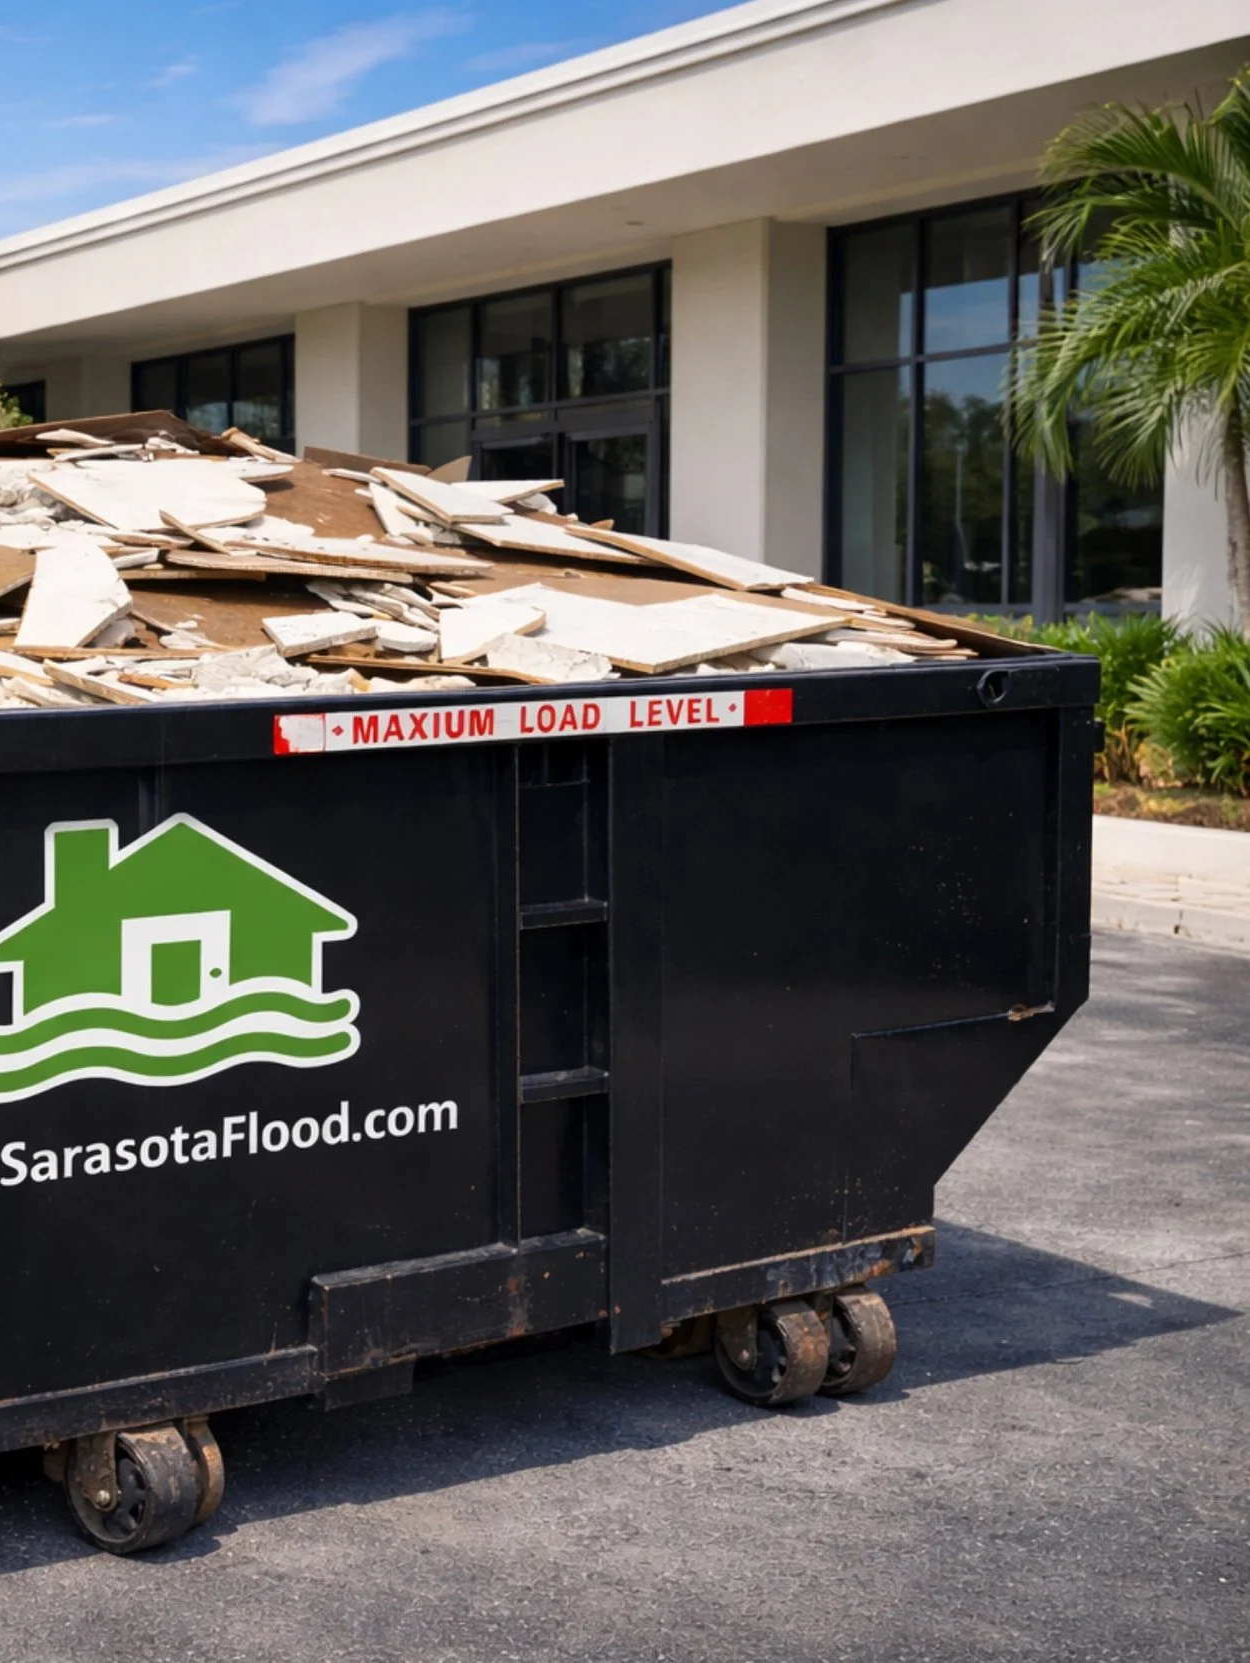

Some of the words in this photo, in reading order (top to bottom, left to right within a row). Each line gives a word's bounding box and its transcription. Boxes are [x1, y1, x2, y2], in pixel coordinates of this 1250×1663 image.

[352, 708, 495, 745] MAXIUM
[519, 702, 601, 733] LOAD
[629, 698, 720, 728] LEVEL
